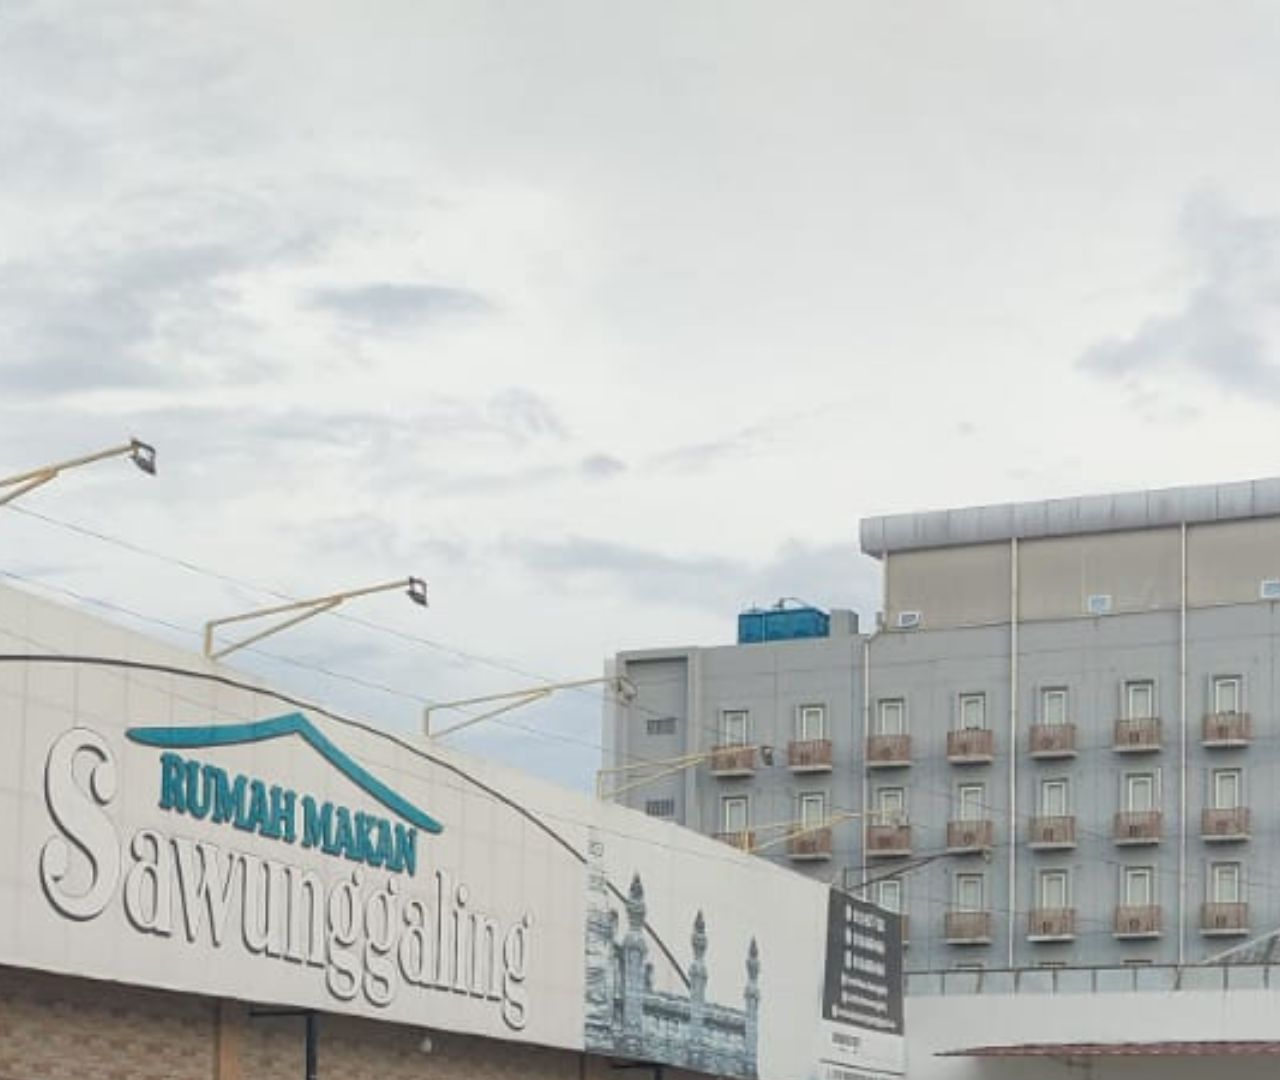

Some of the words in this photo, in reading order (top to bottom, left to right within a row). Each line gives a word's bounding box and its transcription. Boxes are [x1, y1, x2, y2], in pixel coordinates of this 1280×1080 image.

[39, 727, 538, 1031] Sawunggaling
[158, 753, 297, 848] RUMAH
[301, 796, 420, 877] MAKAN
